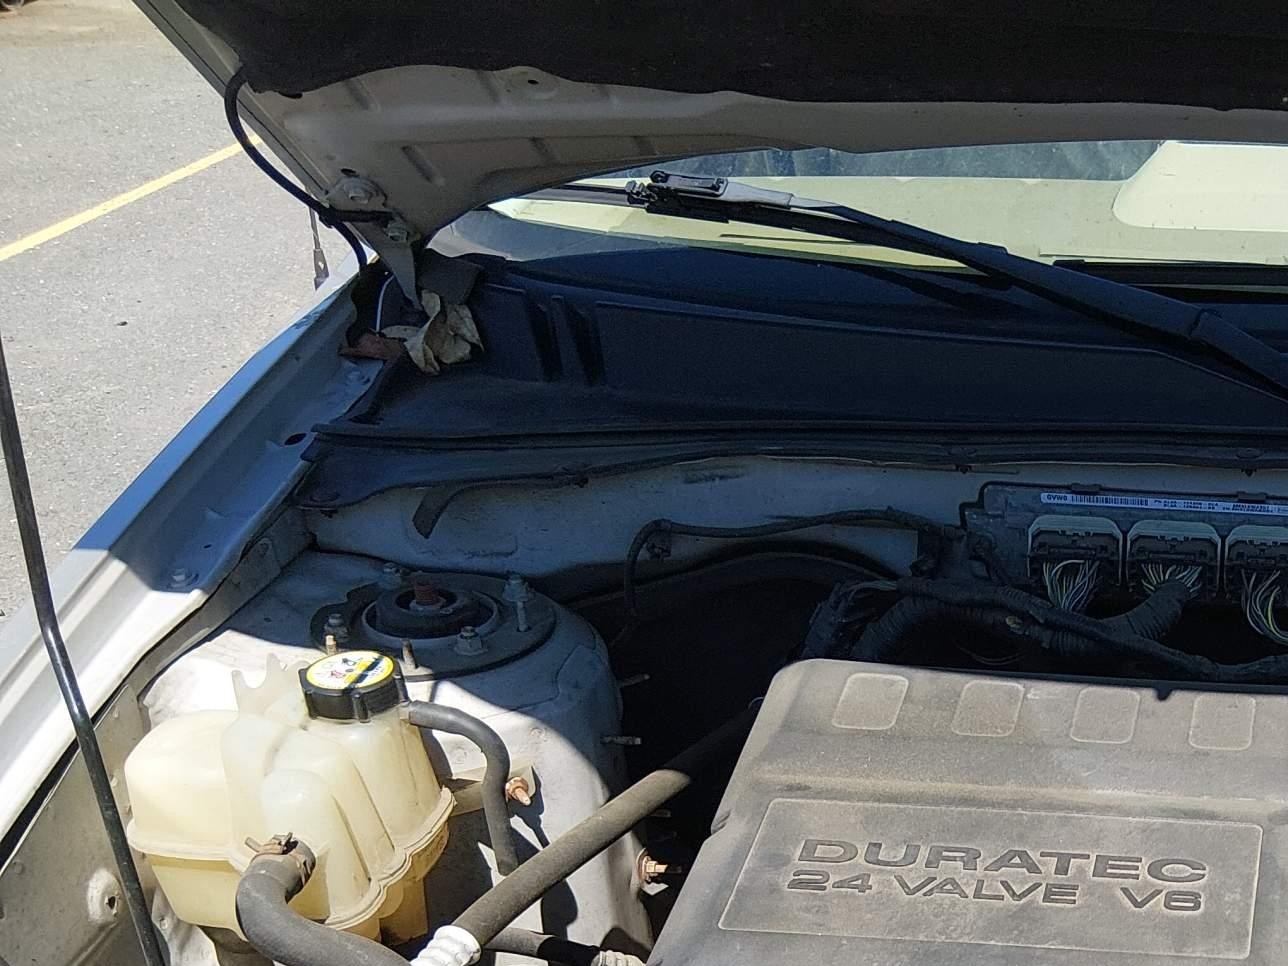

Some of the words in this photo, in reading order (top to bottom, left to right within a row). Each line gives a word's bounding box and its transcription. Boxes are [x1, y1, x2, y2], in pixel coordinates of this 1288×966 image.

[799, 839, 1207, 882] DURATEC
[788, 870, 872, 894] 24
[894, 874, 1079, 905] VALVE
[1120, 887, 1203, 912] V6
